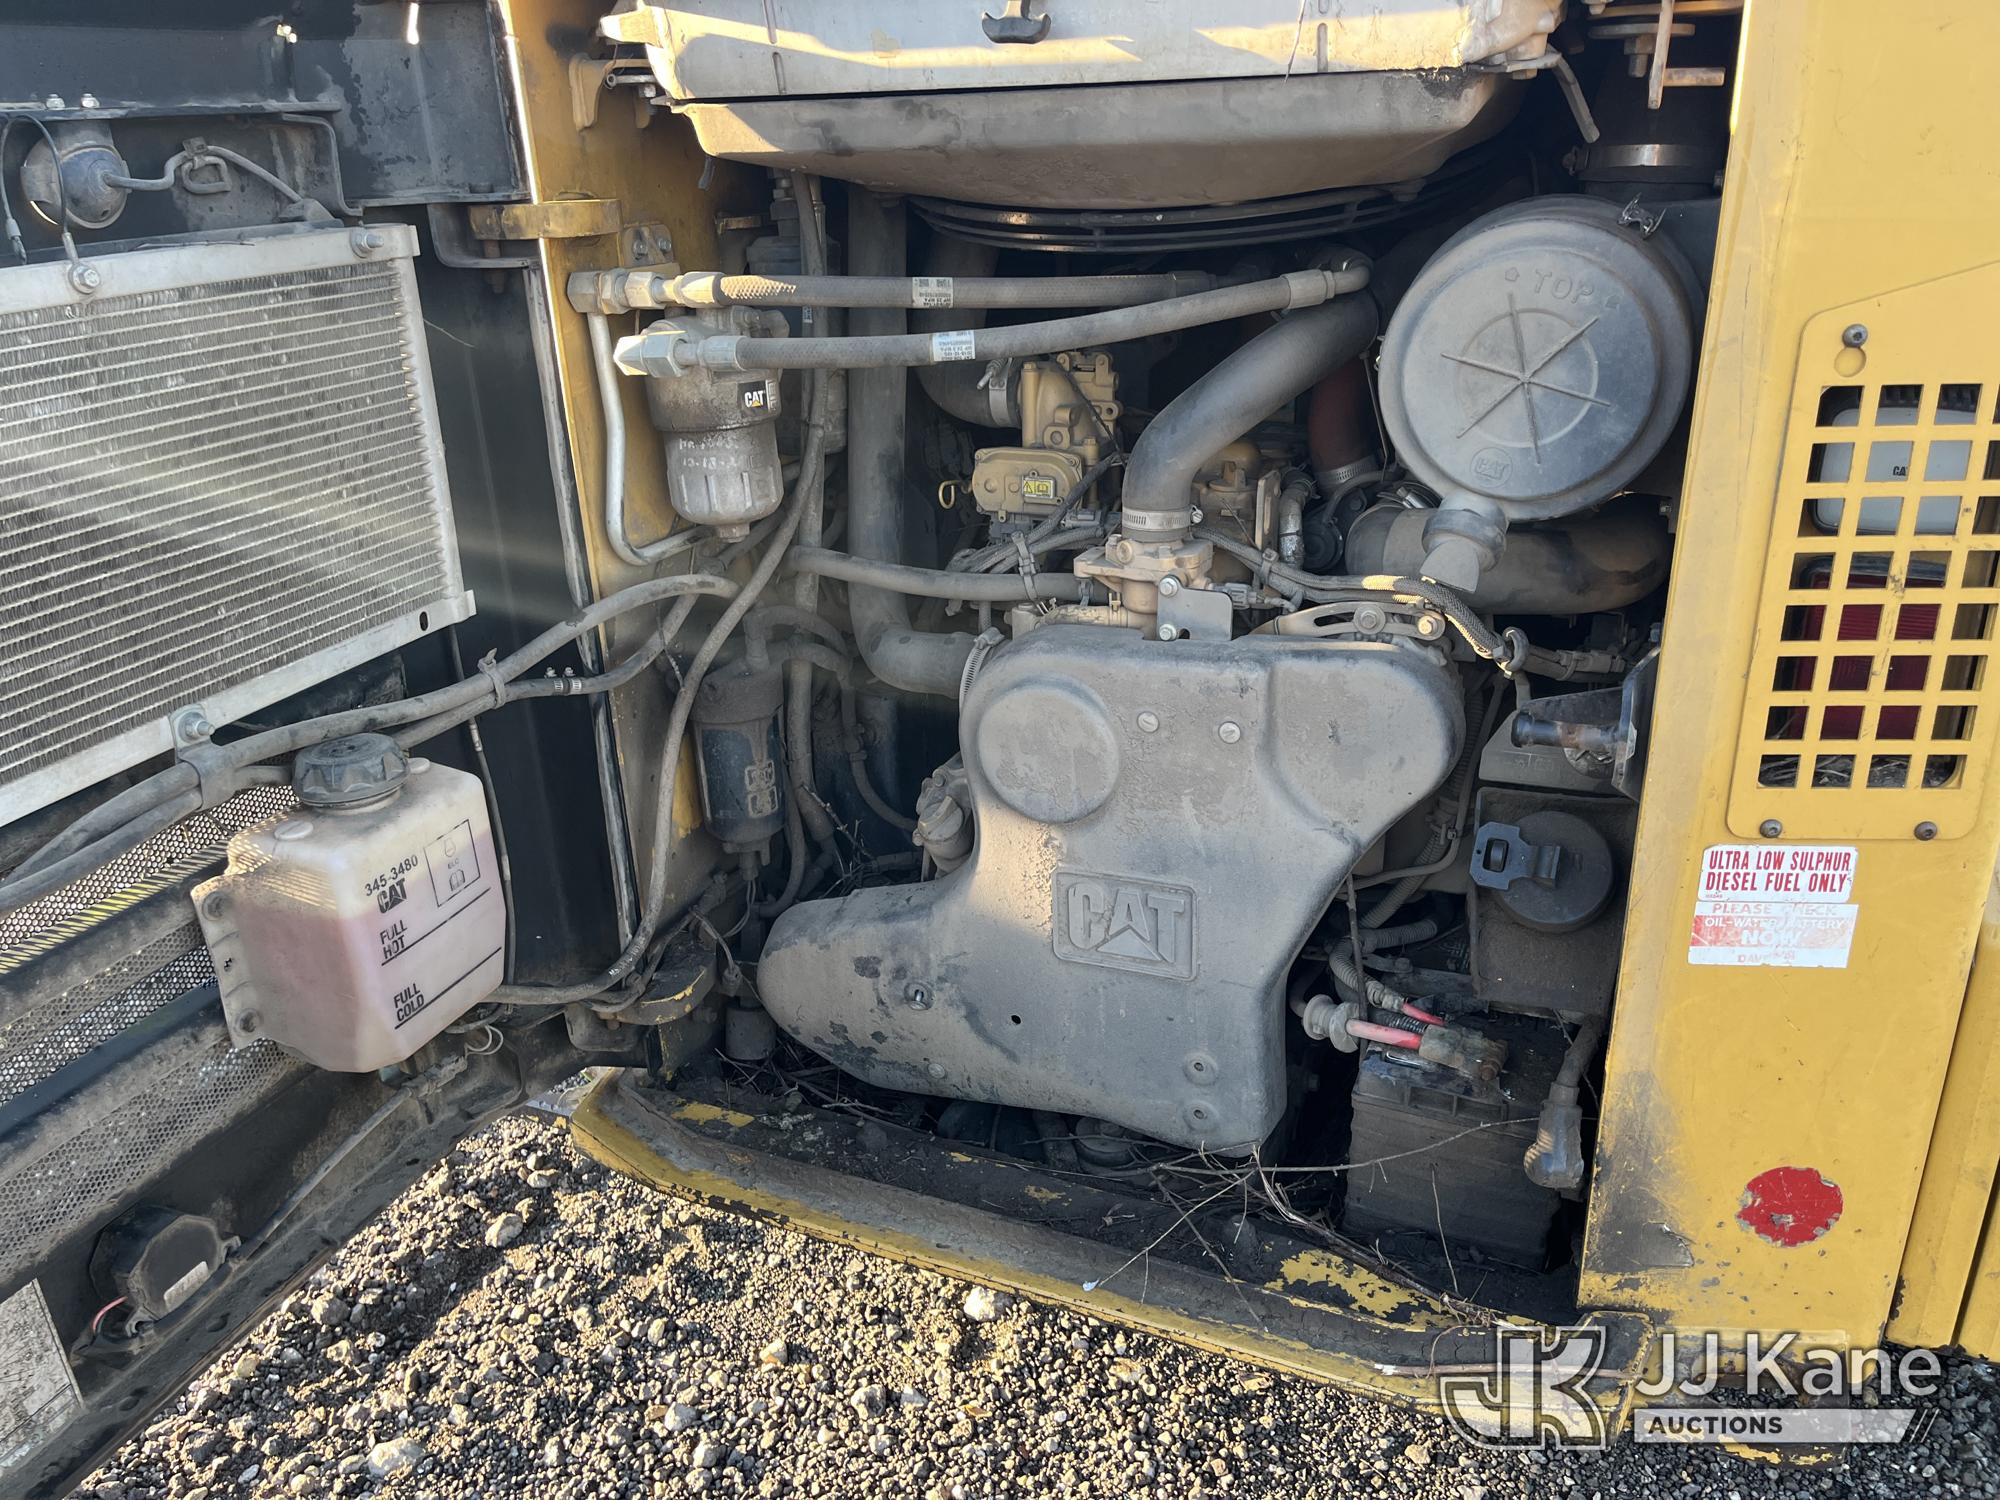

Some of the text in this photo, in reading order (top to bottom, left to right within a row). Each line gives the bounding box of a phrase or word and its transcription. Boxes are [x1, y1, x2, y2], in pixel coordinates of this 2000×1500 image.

[1534, 268, 1594, 304] TOP
[744, 390, 764, 408] CAT
[1892, 465, 1908, 476] CA
[1709, 850, 1851, 872] ULTRA LOW SULPHUR
[365, 854, 418, 897] 345-3480
[1705, 871, 1848, 893] DIESEL FUEL ONLY
[377, 877, 407, 914] CAT
[1712, 903, 1772, 915] PLEASE
[379, 920, 408, 945] FULL
[1068, 882, 1185, 964] CAT
[383, 935, 406, 960] HOT
[393, 983, 421, 1009] FULL
[397, 994, 425, 1023] COLD
